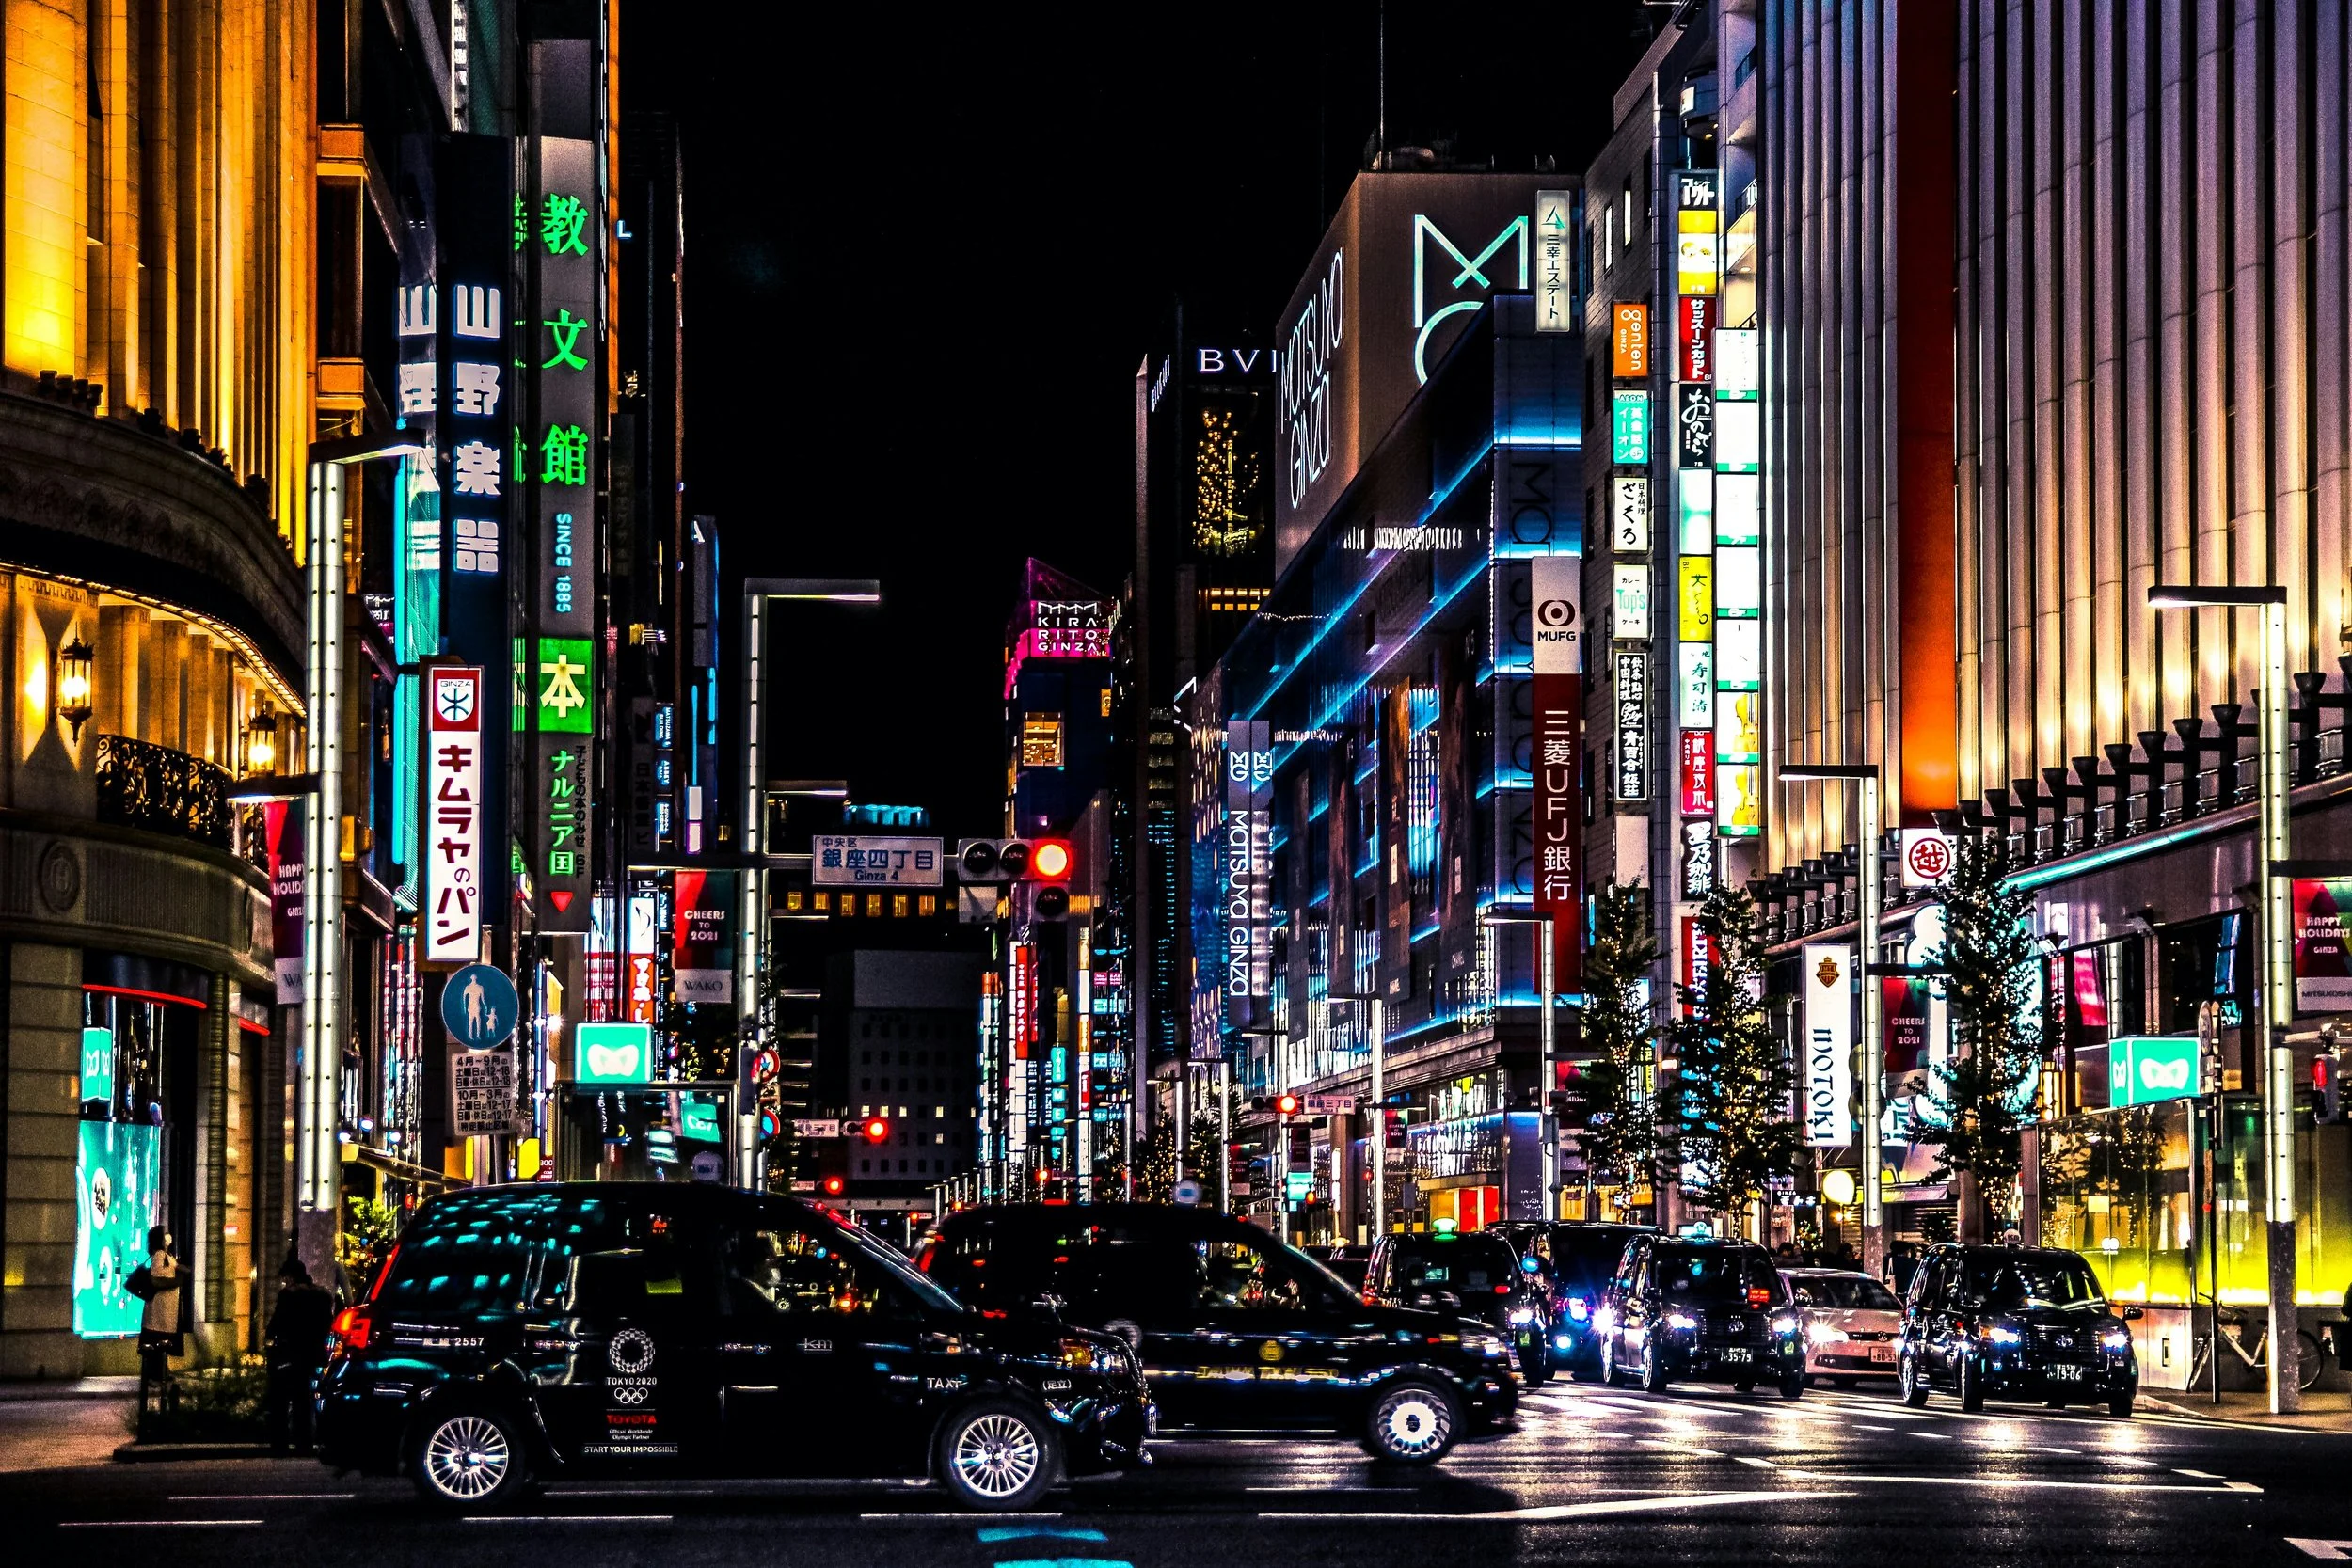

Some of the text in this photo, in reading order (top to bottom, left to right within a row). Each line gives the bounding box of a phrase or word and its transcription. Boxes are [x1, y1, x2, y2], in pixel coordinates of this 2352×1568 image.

[1546, 234, 1561, 320] 三幸エステート
[541, 193, 589, 485] 教文館
[1620, 309, 1642, 371] genten
[456, 285, 501, 572] 山野楽器
[1618, 407, 1629, 459] イーオン
[1622, 483, 1637, 546] ざくろ
[555, 513, 572, 613] SINCE 1885
[1616, 589, 1646, 614] Top's
[1038, 617, 1097, 627] KIRA
[1038, 630, 1098, 640] RITO
[1537, 630, 1576, 641] MUFG
[1038, 642, 1098, 651] GINZA
[540, 654, 586, 718] 本
[1544, 710, 1571, 900] 三菱UFJ銀行
[549, 750, 575, 876] ナルニア国
[437, 745, 476, 946] キムラヤのパン
[822, 837, 858, 847] 中央区
[822, 848, 933, 869] 銀座四丁目
[855, 870, 899, 881] Ginza 4
[684, 911, 725, 920] CHEERS
[2307, 917, 2342, 927] HAPPY
[691, 931, 718, 941] 2021
[2298, 928, 2350, 938] HOLIDAYS
[684, 981, 723, 991] WAKO
[1892, 1018, 1925, 1026] CHEERS
[454, 1338, 484, 1346] 2557
[1727, 1352, 1752, 1362] 35-79
[2056, 1370, 2081, 1380] 19-06
[606, 1377, 657, 1386] TOKYO 2020
[606, 1415, 657, 1424] TOYOTA
